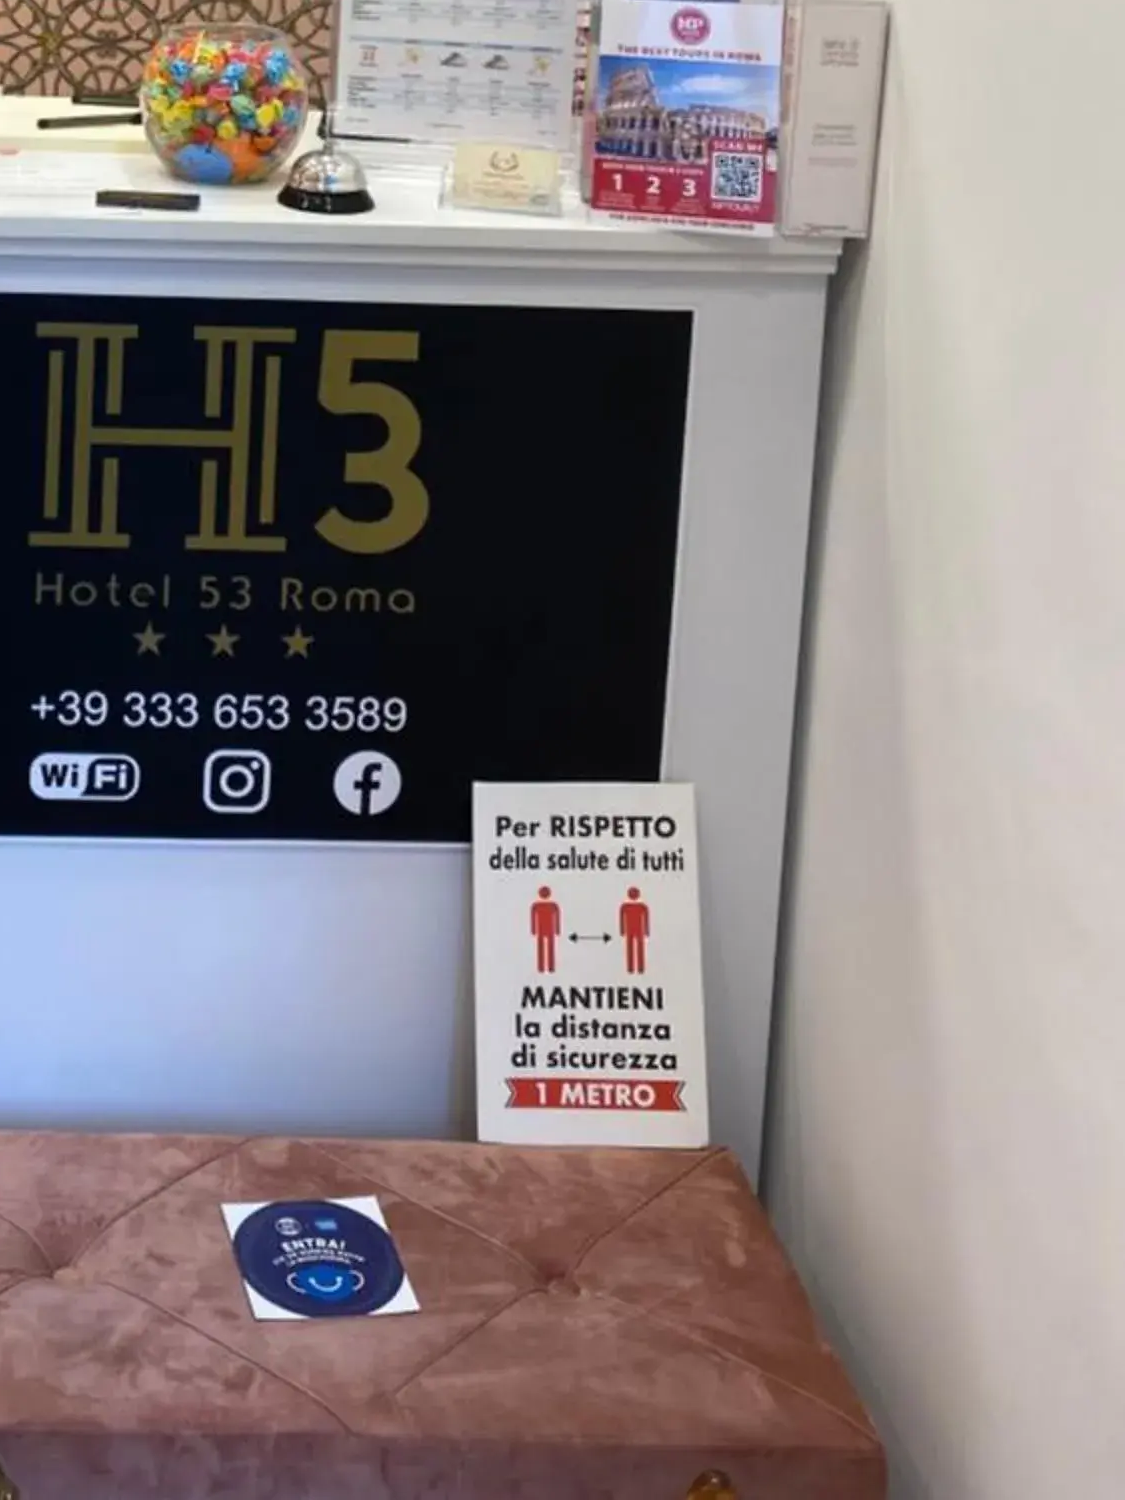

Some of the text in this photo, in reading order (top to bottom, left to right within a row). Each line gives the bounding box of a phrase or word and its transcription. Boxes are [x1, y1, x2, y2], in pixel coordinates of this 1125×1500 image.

[612, 173, 697, 197] 1 2 3
[34, 571, 417, 614] Hotel 53 Roma
[31, 690, 408, 732] +39 333 653 3589
[495, 815, 677, 839] Per RISPETTO
[488, 846, 685, 872] della salute di tutti
[521, 986, 664, 1011] MANTIENI
[515, 1013, 671, 1041] la distanza
[511, 1044, 678, 1071] di sicurezza
[536, 1083, 656, 1107] 1 METRO
[280, 1237, 346, 1253] ENTRA!
